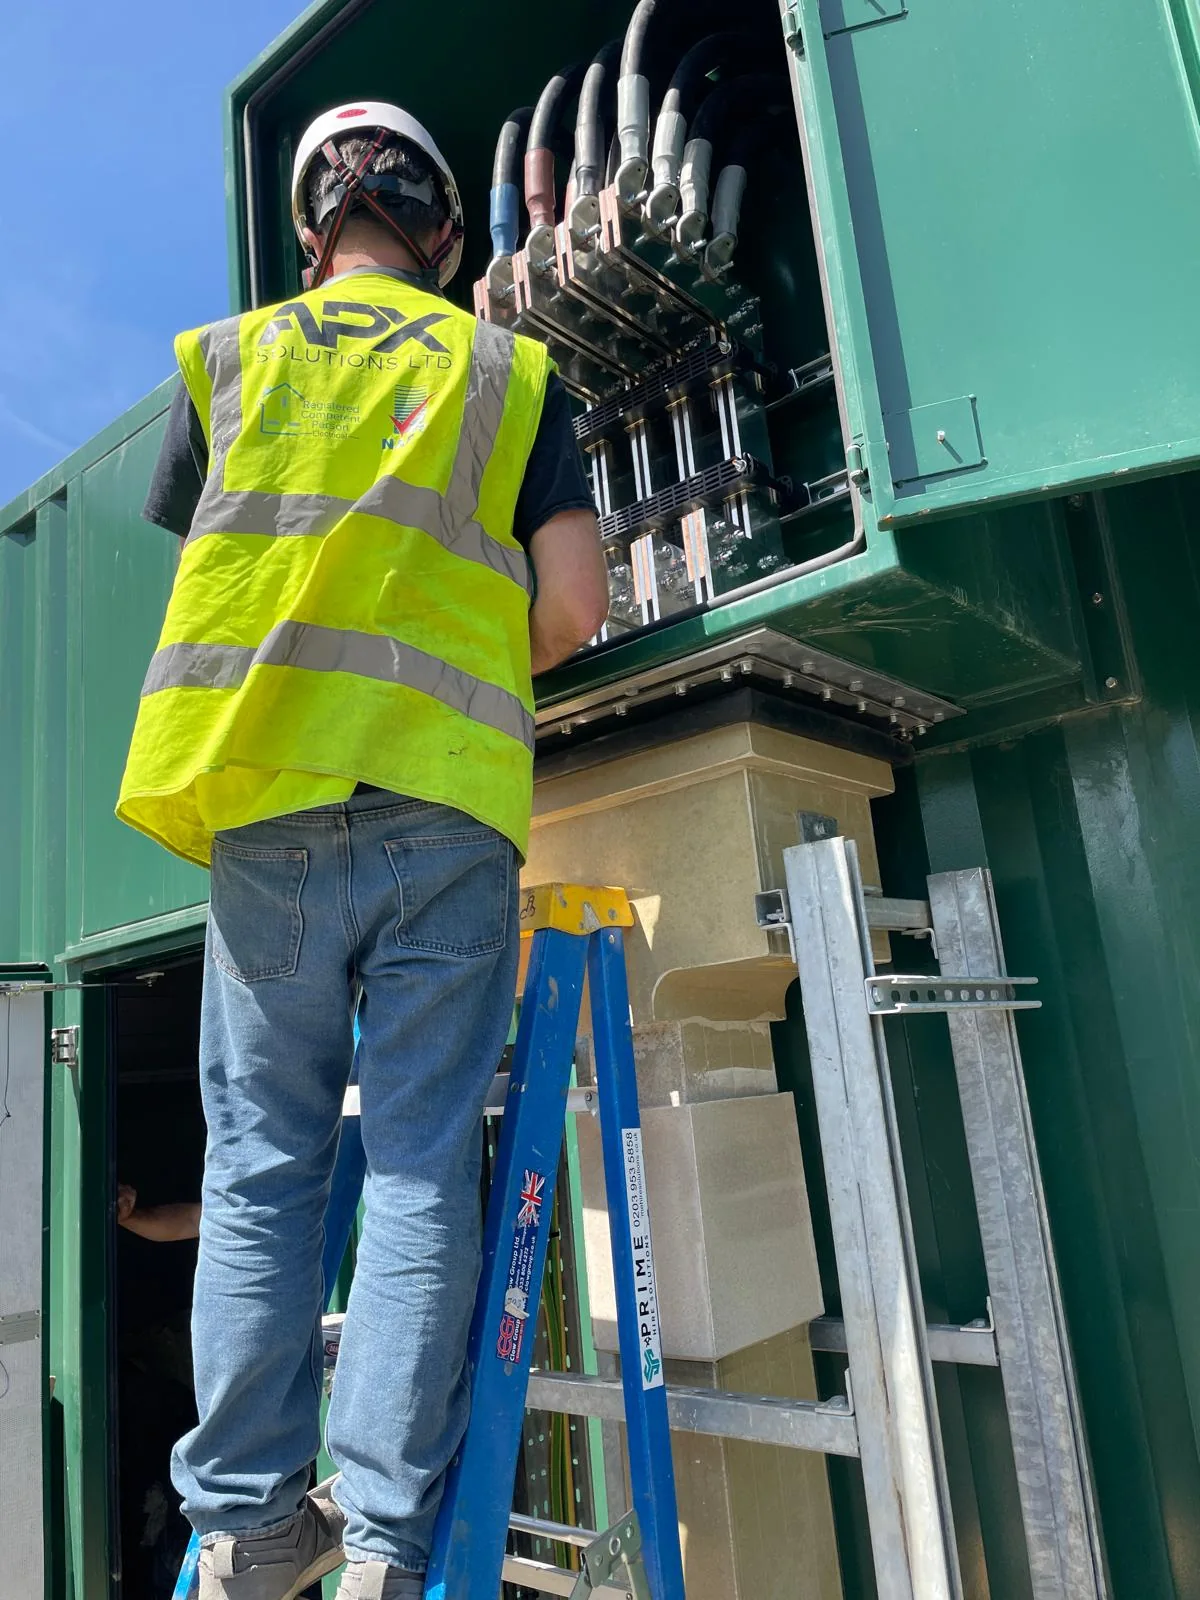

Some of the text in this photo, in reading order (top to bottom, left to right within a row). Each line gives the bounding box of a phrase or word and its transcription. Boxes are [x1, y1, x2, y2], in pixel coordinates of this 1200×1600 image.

[258, 301, 454, 353] APX
[257, 345, 452, 370] SOLUTIONS LTD
[625, 1132, 641, 1228] 0203 953 5858
[509, 1250, 518, 1275] Group
[644, 1234, 654, 1301] SOLUTIONS
[633, 1236, 651, 1338] PRIME
[512, 1319, 521, 1341] Group
[509, 1342, 517, 1361] Clow
